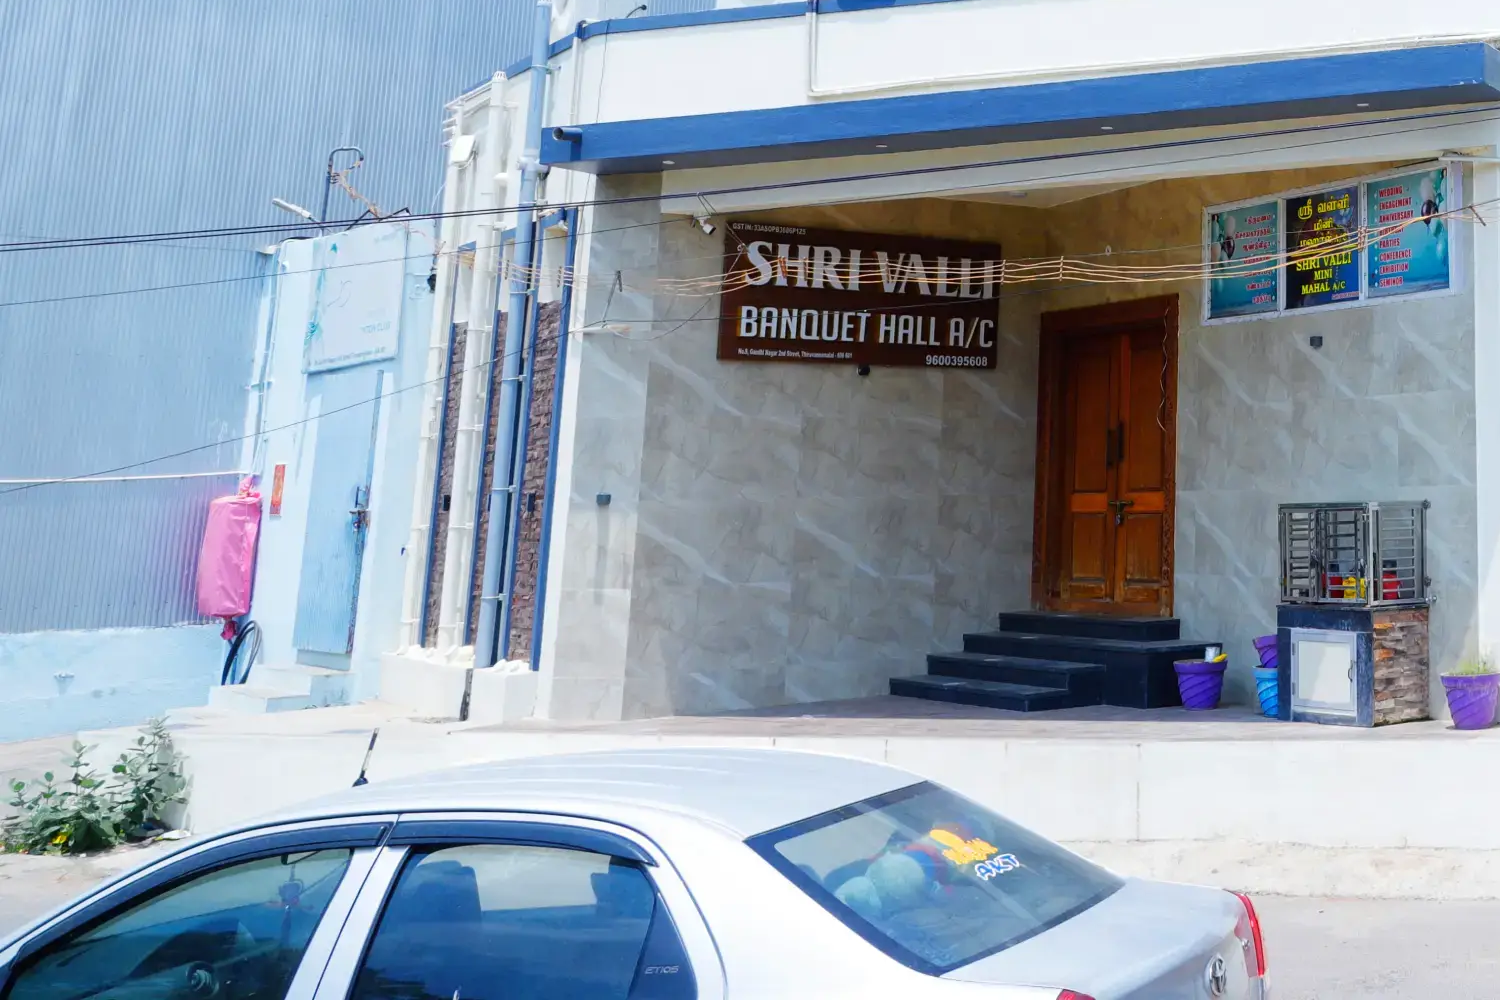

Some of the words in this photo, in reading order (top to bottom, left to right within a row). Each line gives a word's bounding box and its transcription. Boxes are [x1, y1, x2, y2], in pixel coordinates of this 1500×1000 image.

[1379, 186, 1403, 197] WEDDING
[1317, 194, 1349, 214] வள்ளி
[1379, 197, 1412, 210] ENGAGEMENT
[1379, 210, 1414, 223] ANNIVERSARY
[1313, 217, 1334, 232] மினி
[1379, 238, 1400, 249] PARTIES
[1296, 257, 1321, 271] SHRI
[1323, 252, 1352, 266] VALLI
[1379, 249, 1412, 261] CONFERENCE
[745, 240, 861, 291] SHRI
[875, 250, 995, 300] VALLI
[1314, 268, 1333, 280] MINI
[1379, 263, 1409, 274] EXHIBITION
[1301, 282, 1330, 295] MAHAL
[1332, 281, 1346, 292] A/C
[739, 305, 871, 343] BANQUET
[878, 313, 940, 347] HALL
[949, 317, 994, 349] A/C
[925, 355, 988, 367] 9600395608
[974, 853, 1020, 881] AKT
[644, 965, 679, 974] ETIOS
